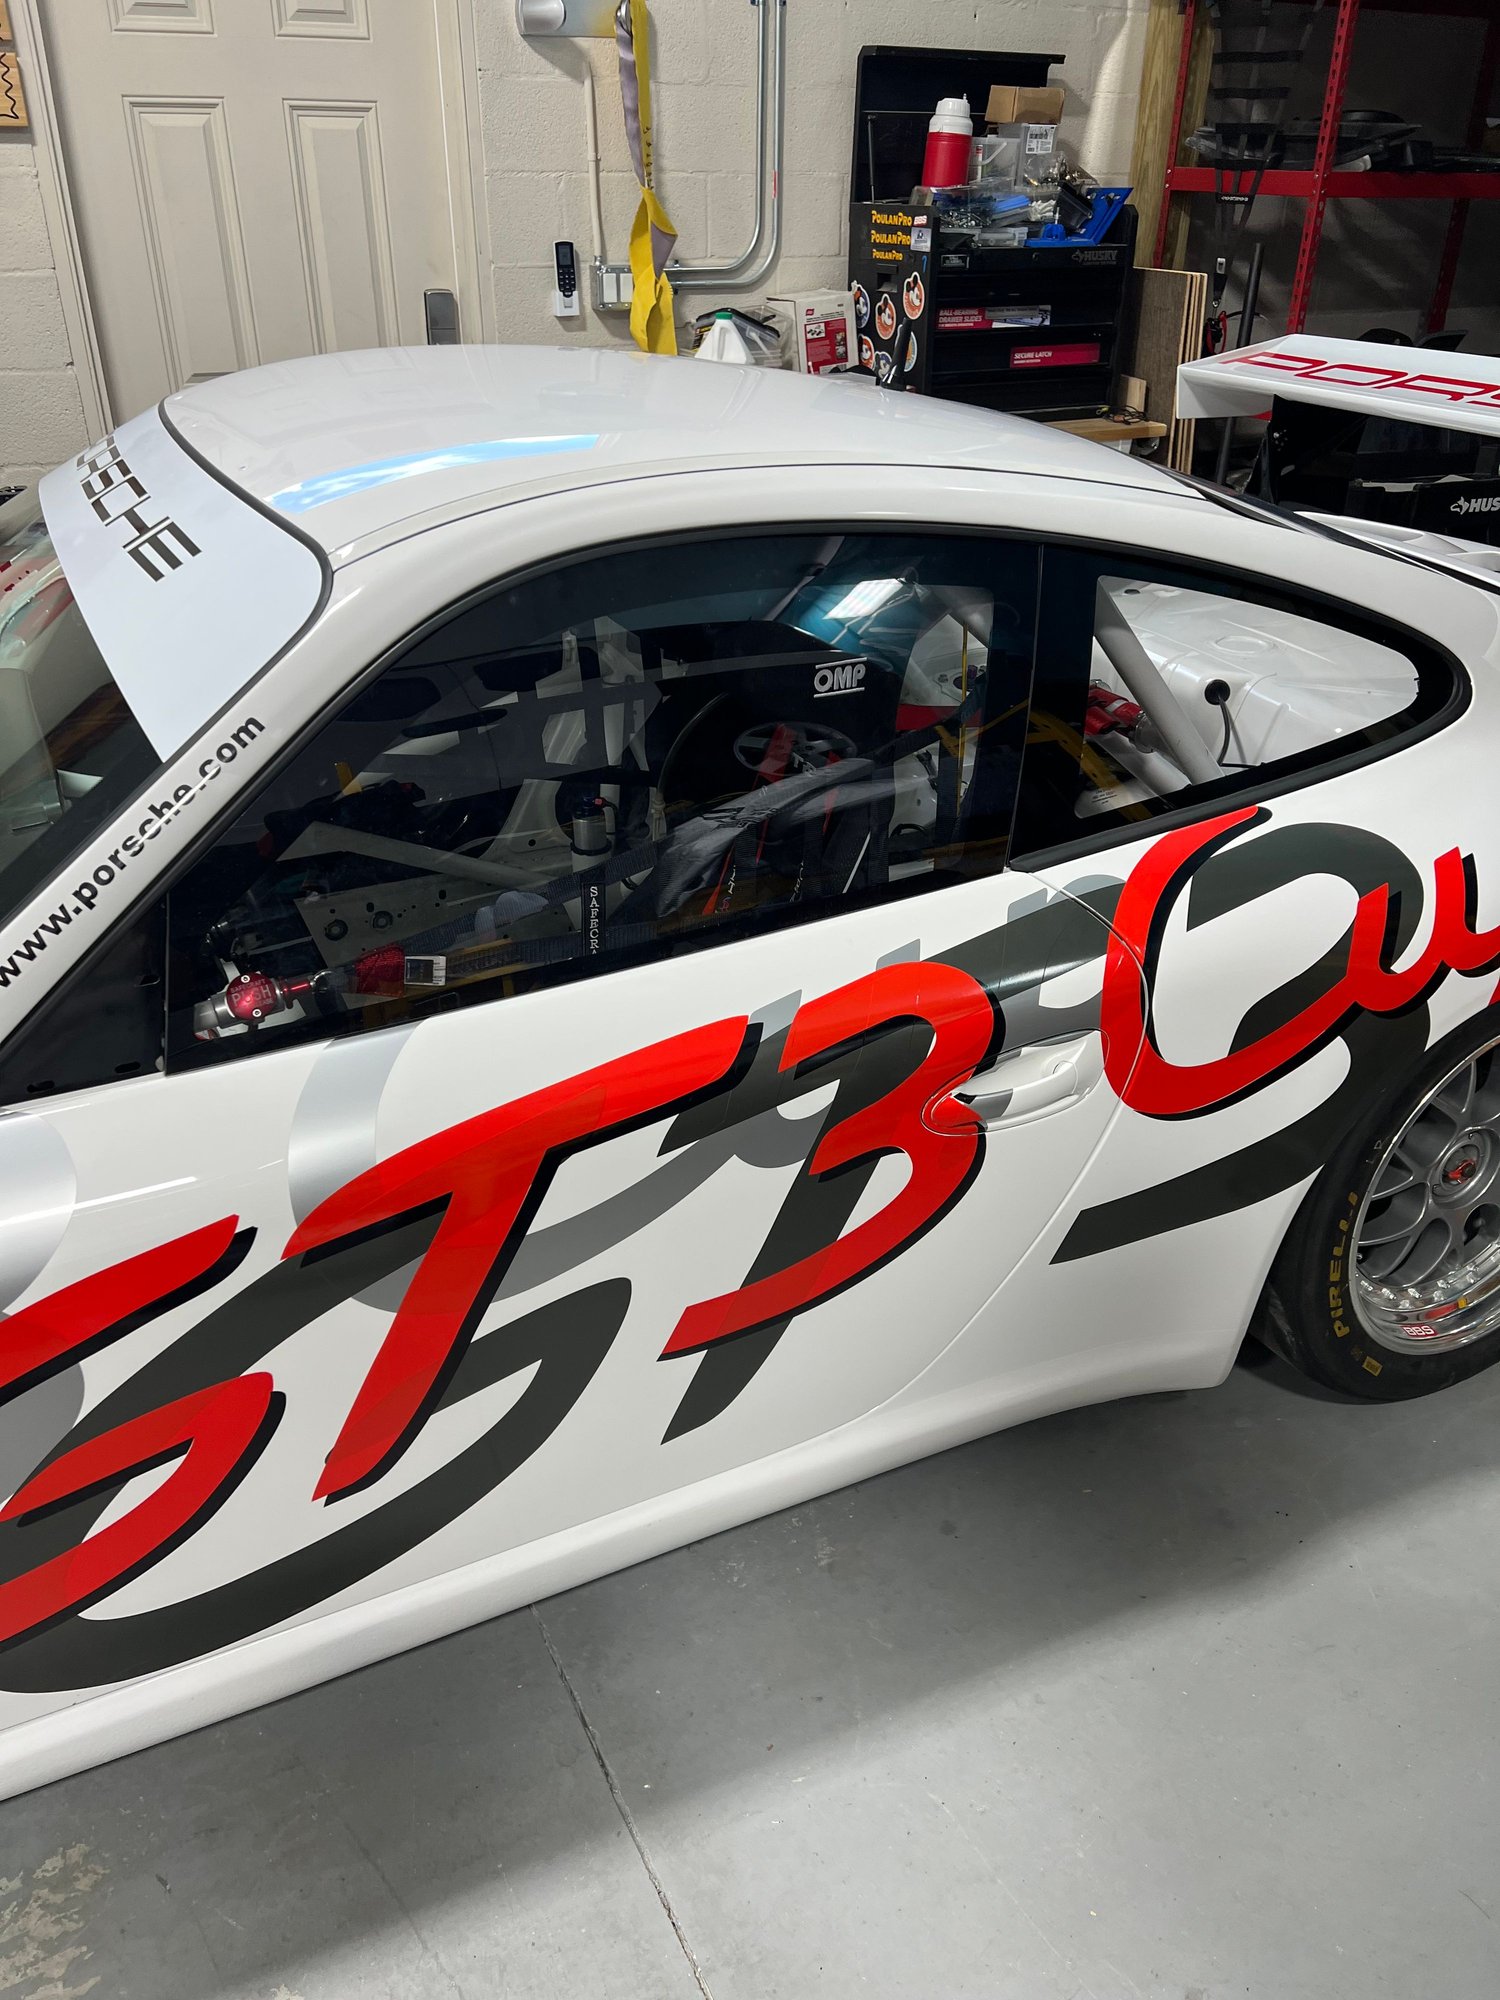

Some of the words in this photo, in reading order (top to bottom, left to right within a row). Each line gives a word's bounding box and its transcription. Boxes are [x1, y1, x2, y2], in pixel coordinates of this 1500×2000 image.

[813, 663, 867, 693] OMP
[0, 716, 266, 988] www.porsche.com
[1328, 1190, 1359, 1338] PIRELLI
[1402, 1325, 1435, 1336] BBS
